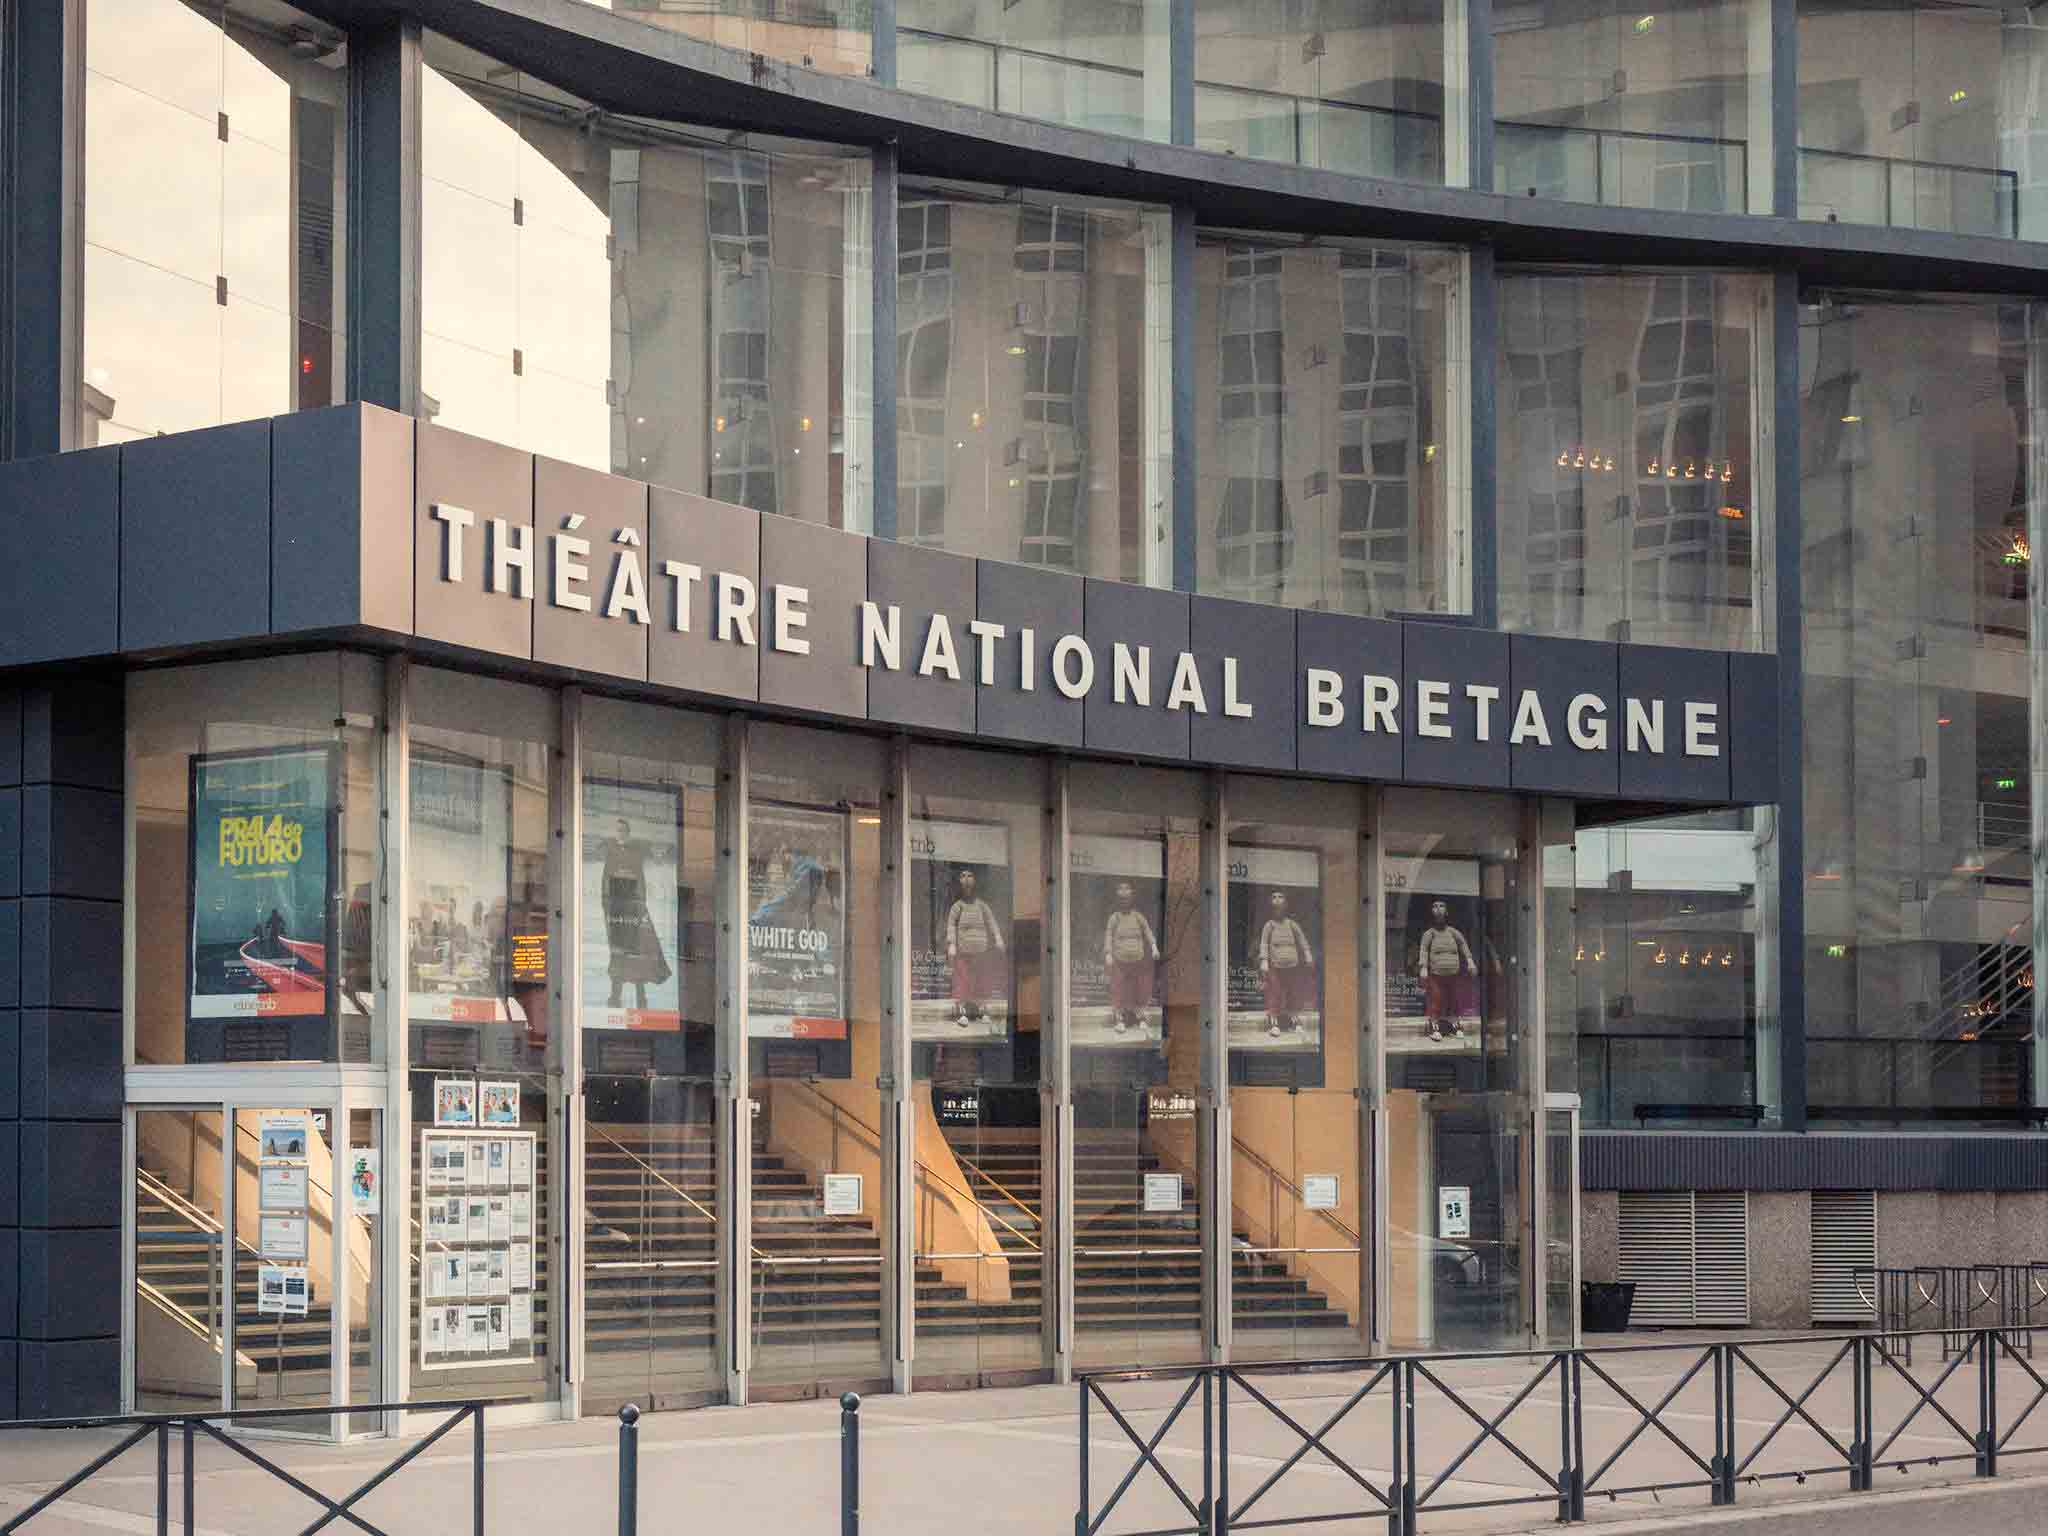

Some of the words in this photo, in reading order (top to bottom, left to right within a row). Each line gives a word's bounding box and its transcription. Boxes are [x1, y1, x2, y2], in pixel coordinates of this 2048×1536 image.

[433, 503, 811, 656] THÉÂTRE
[861, 601, 1253, 718] NATIONAL
[1306, 667, 1721, 757] BRETAGNE
[220, 832, 303, 866] FUTURO
[751, 926, 795, 950] WHITE
[799, 928, 828, 952] GOD
